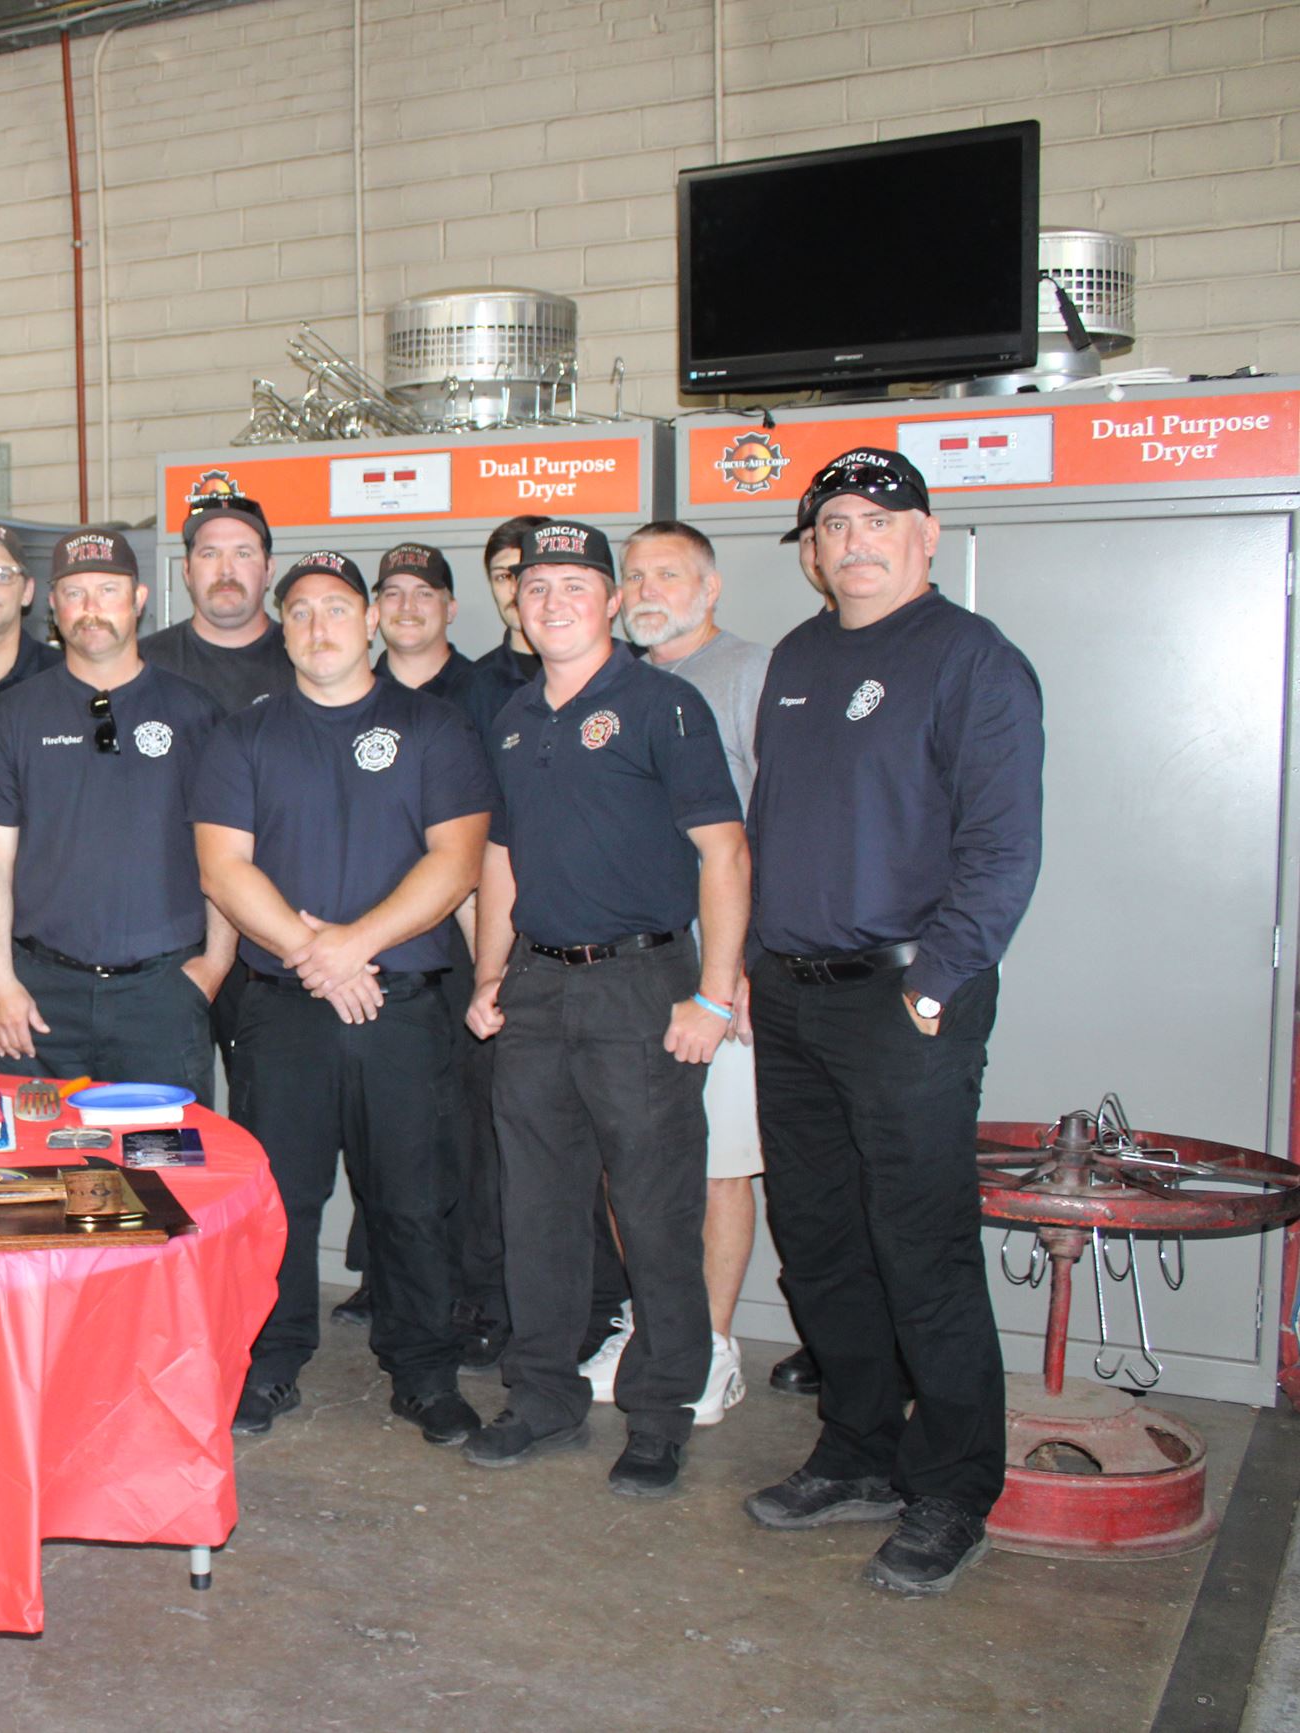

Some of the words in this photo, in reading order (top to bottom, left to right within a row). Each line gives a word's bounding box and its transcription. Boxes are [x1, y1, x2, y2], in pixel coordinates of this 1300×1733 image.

[1091, 416, 1154, 440] Dual
[1162, 414, 1271, 439] Purpose
[1140, 442, 1218, 467] Dryer
[479, 457, 529, 478] Dual
[534, 456, 617, 480] Purpose
[518, 479, 577, 503] Dryer
[66, 534, 115, 551] DUNCAN
[535, 525, 589, 541] DUNCAN
[67, 543, 113, 564] FIRE
[536, 535, 586, 555] FIRE
